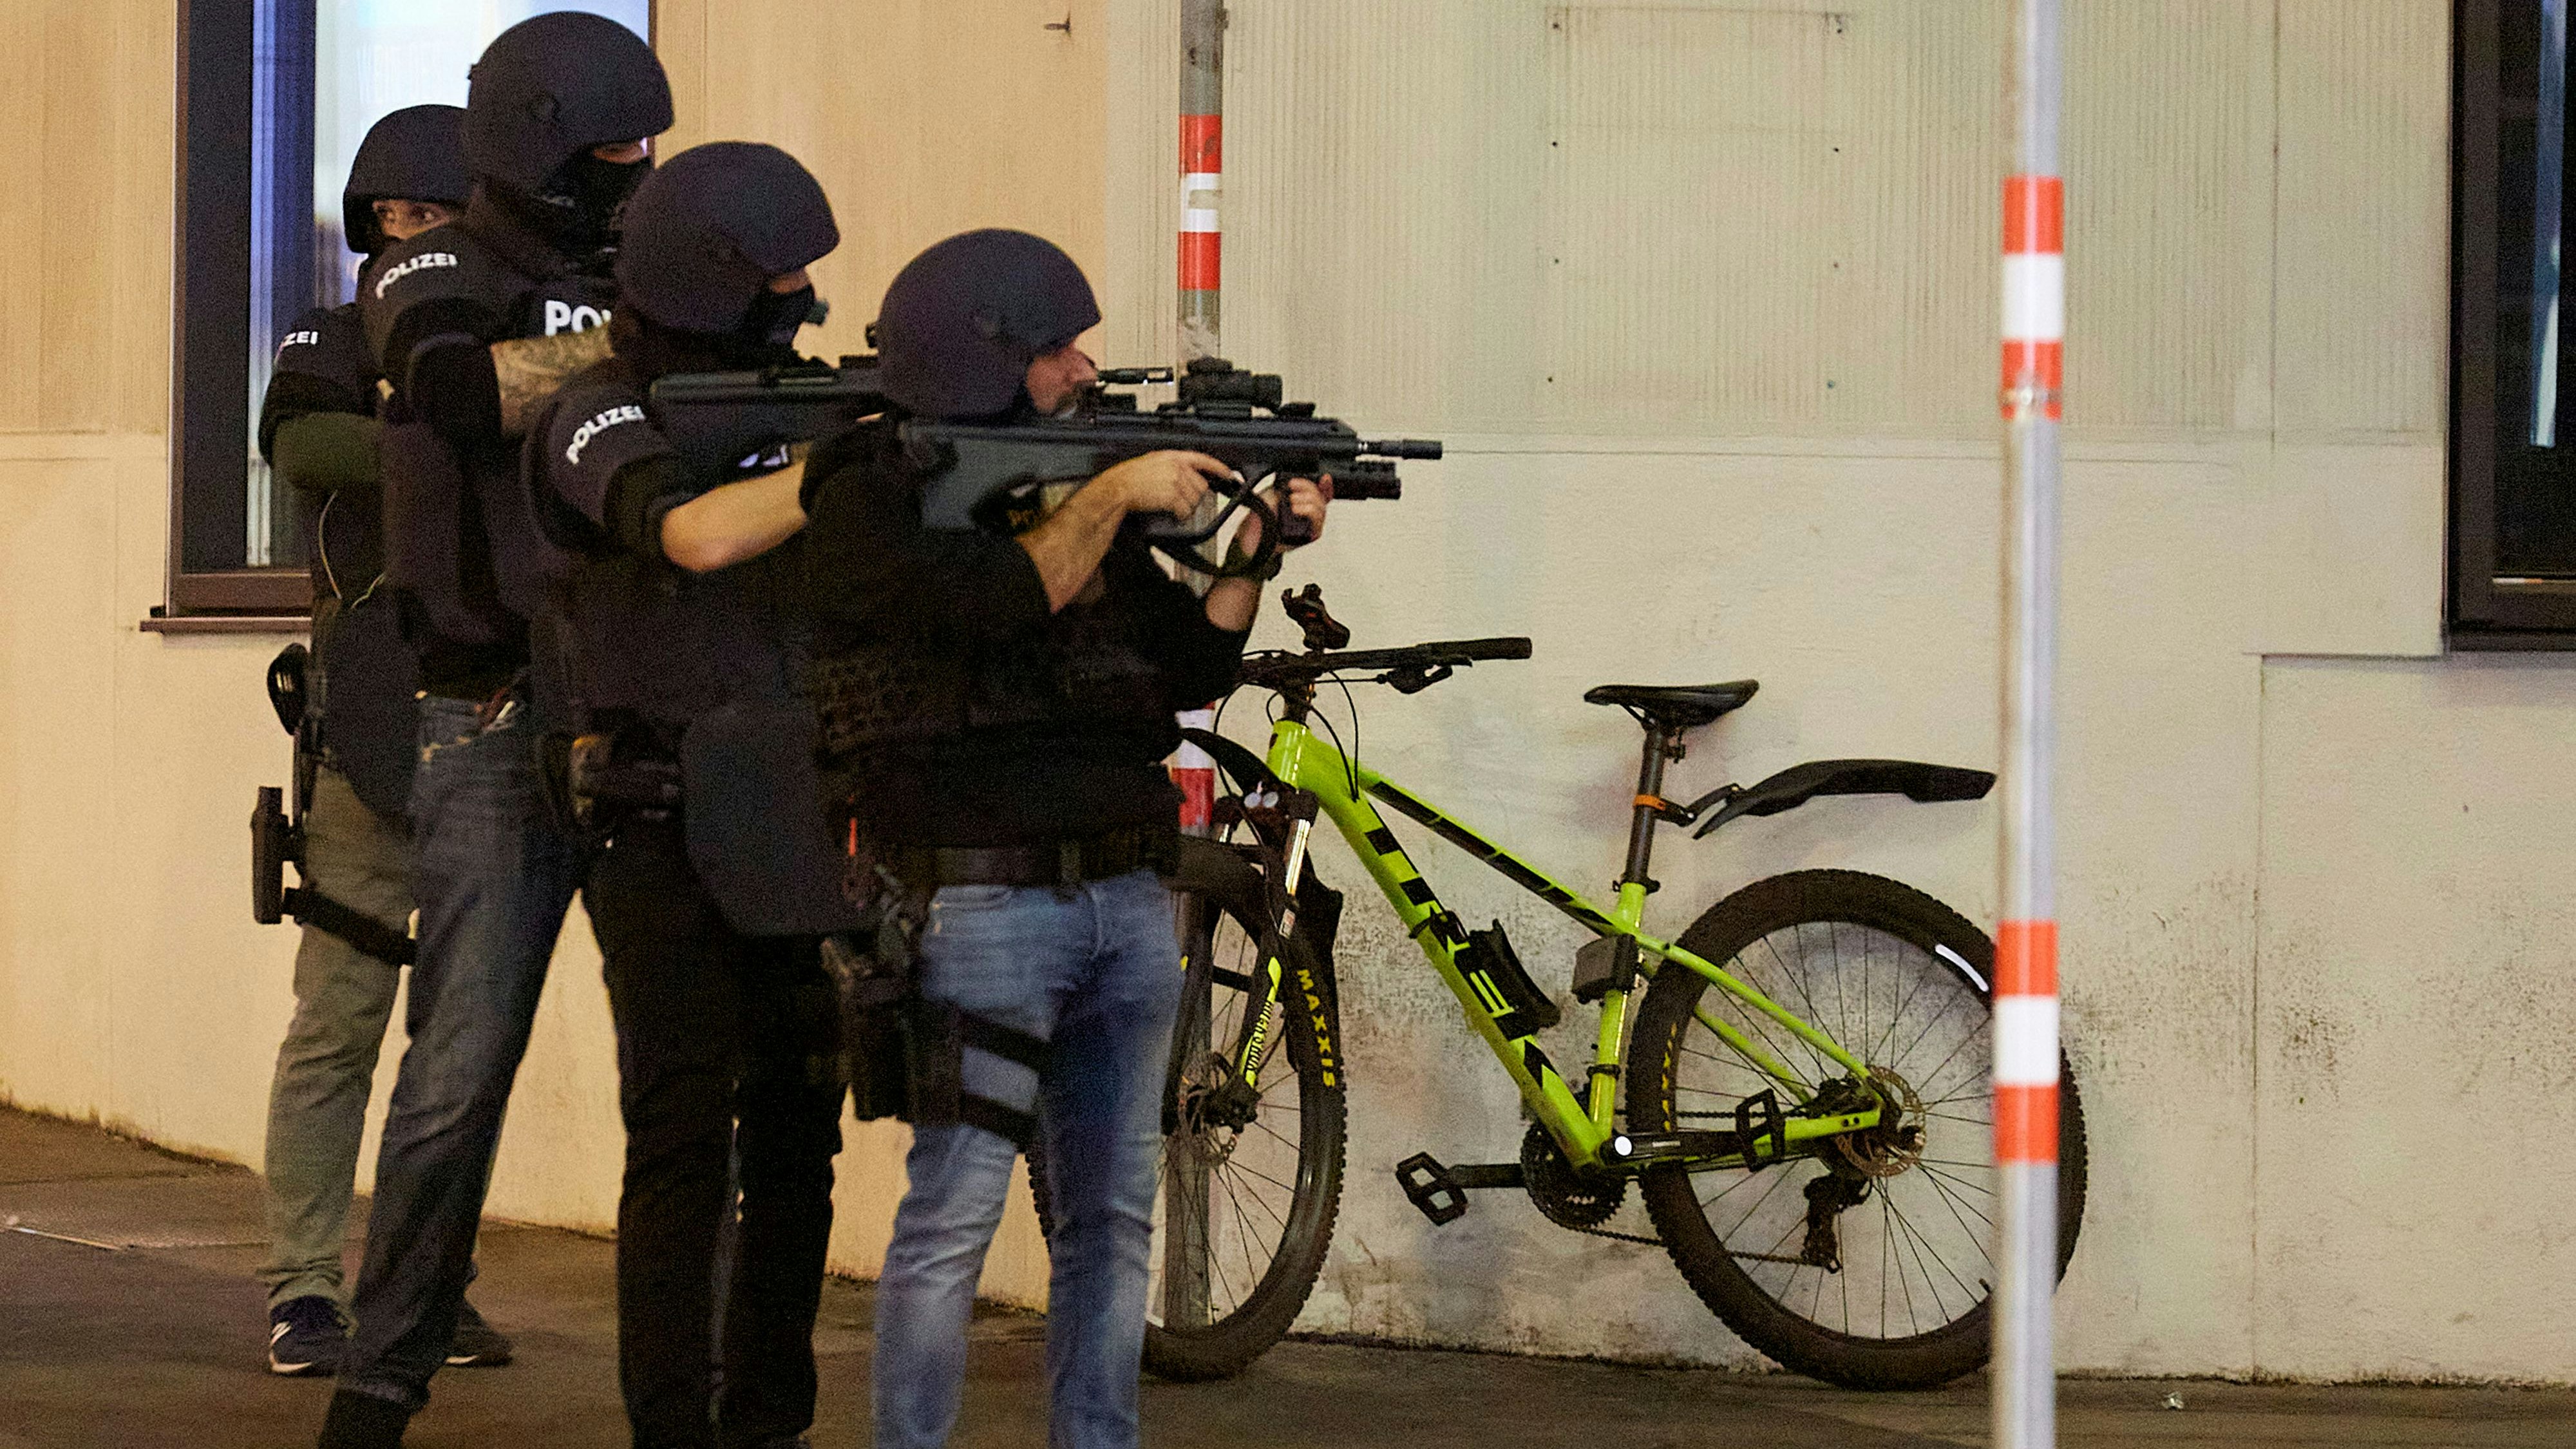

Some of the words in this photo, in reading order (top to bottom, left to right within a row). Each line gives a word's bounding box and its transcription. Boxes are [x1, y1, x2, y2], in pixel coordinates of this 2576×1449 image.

[375, 252, 458, 299] POLIZEI
[566, 405, 646, 464] POLIZEI
[1363, 797, 1560, 1090] TREK
[1297, 969, 1336, 1086] MAXXIS
